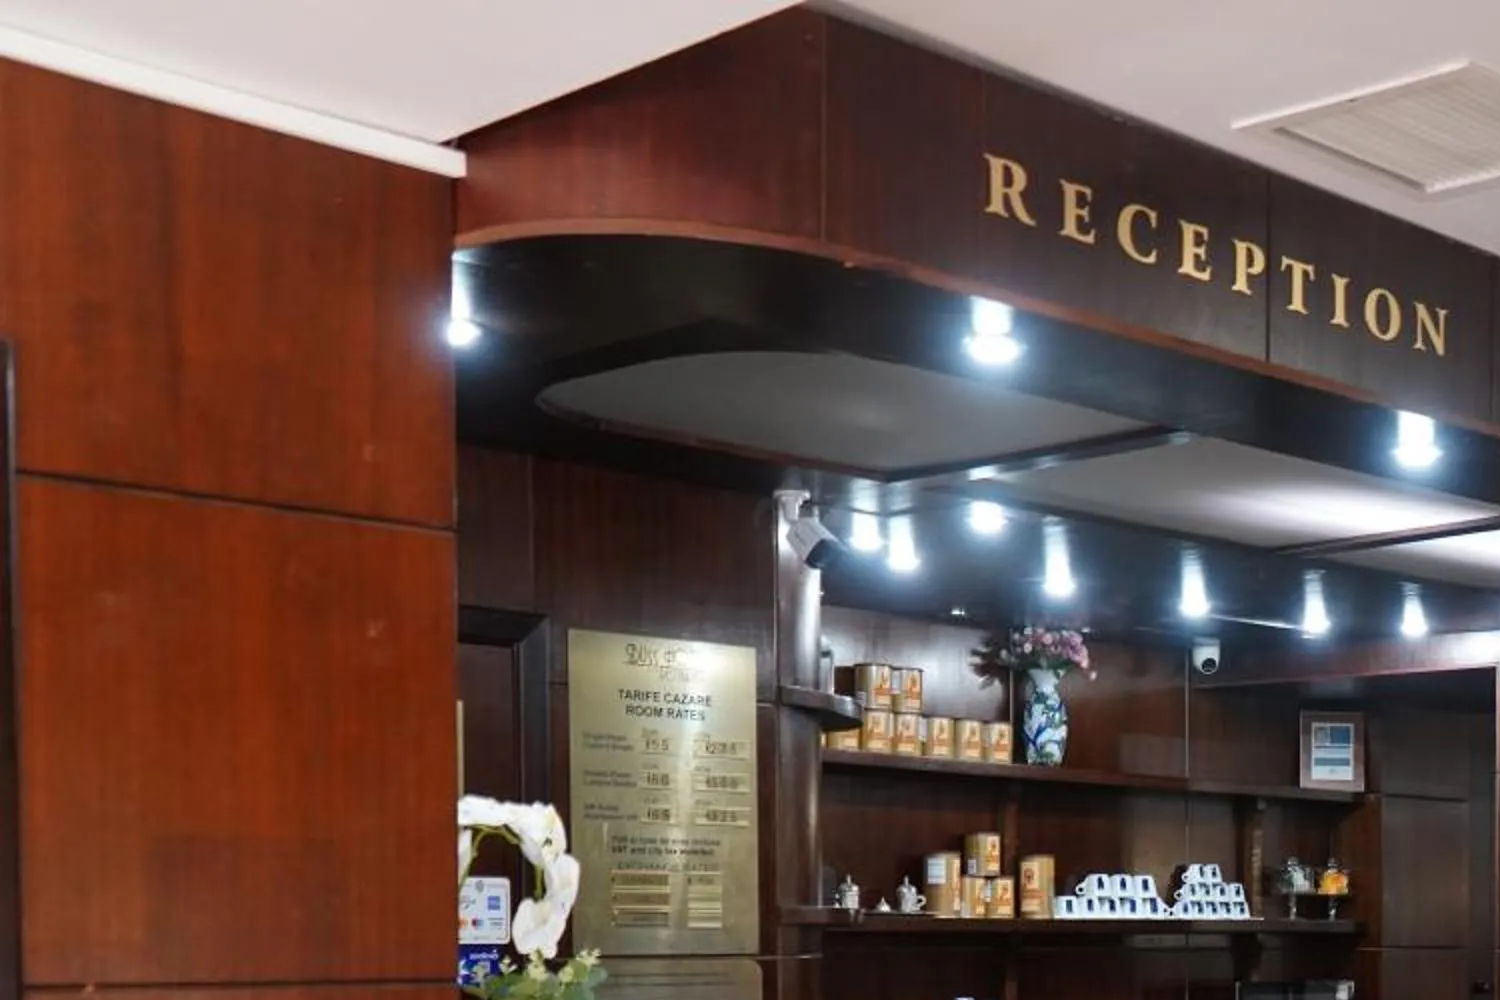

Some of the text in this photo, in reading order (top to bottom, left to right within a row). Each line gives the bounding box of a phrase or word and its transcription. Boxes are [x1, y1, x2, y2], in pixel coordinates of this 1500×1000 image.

[983, 152, 1448, 358] RECEPTION
[618, 688, 712, 707] TARIFE CAZARE
[625, 704, 705, 721] ROOM RATES
